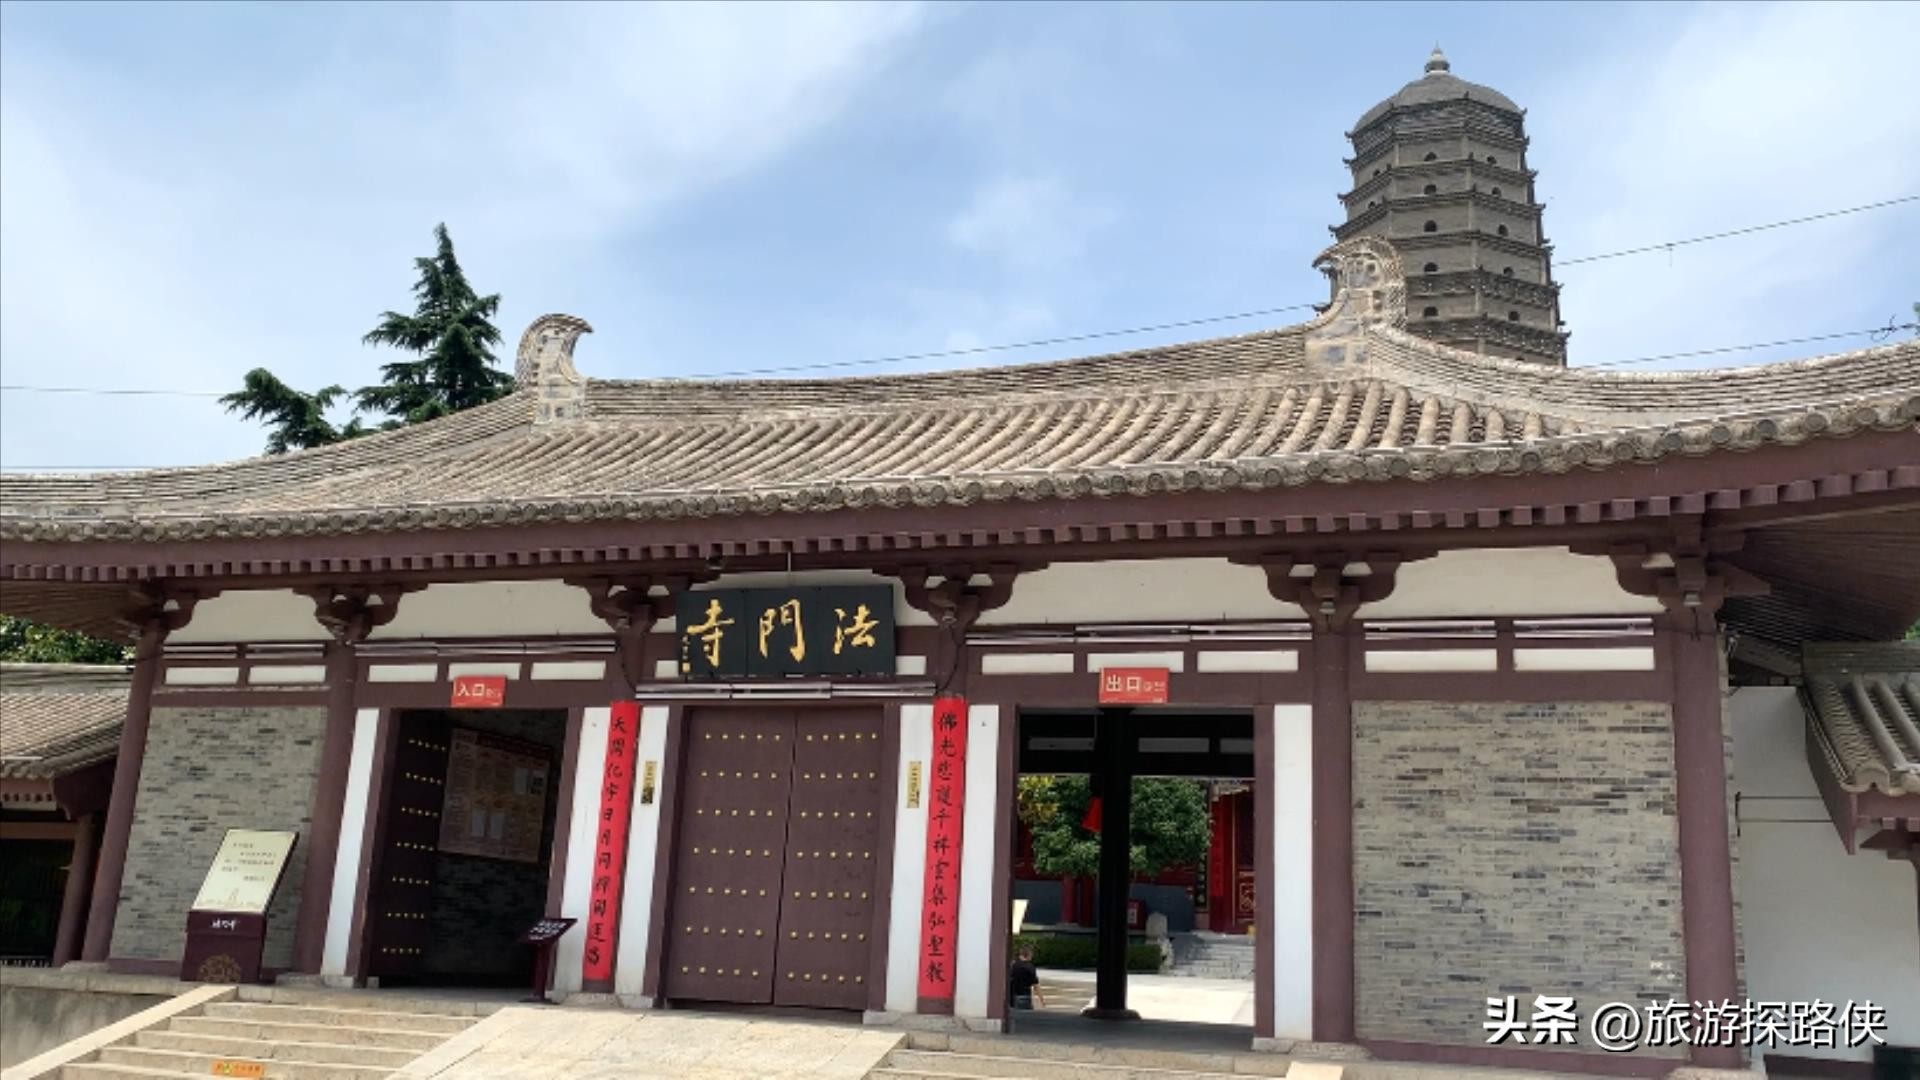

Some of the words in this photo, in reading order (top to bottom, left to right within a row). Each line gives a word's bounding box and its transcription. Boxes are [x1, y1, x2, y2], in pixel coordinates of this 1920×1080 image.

[687, 599, 879, 667] 法門寺
[457, 681, 486, 697] 入口
[1105, 674, 1141, 692] 出口
